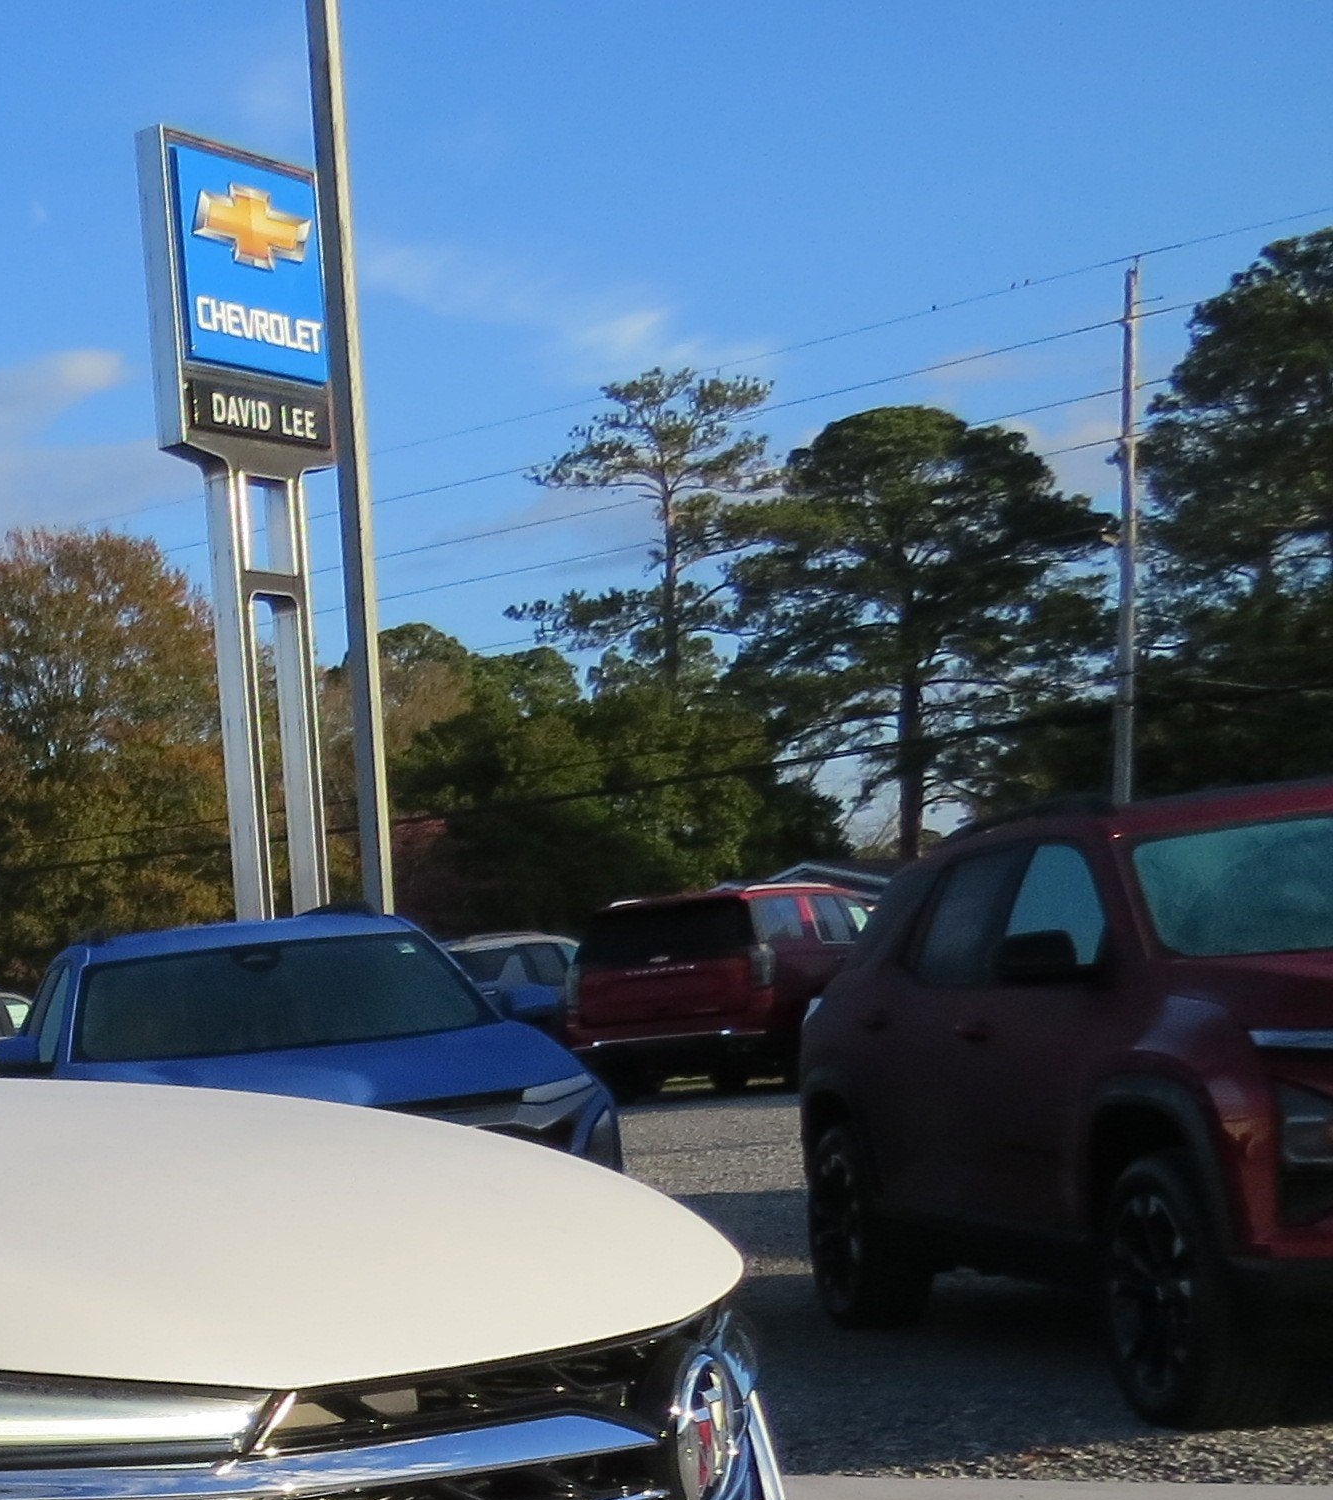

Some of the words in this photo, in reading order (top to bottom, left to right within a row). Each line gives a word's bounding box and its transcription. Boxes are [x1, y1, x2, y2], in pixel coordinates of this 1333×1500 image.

[196, 295, 323, 354] CHEVROLET
[211, 392, 272, 432] DAVID
[280, 405, 318, 440] LEE
